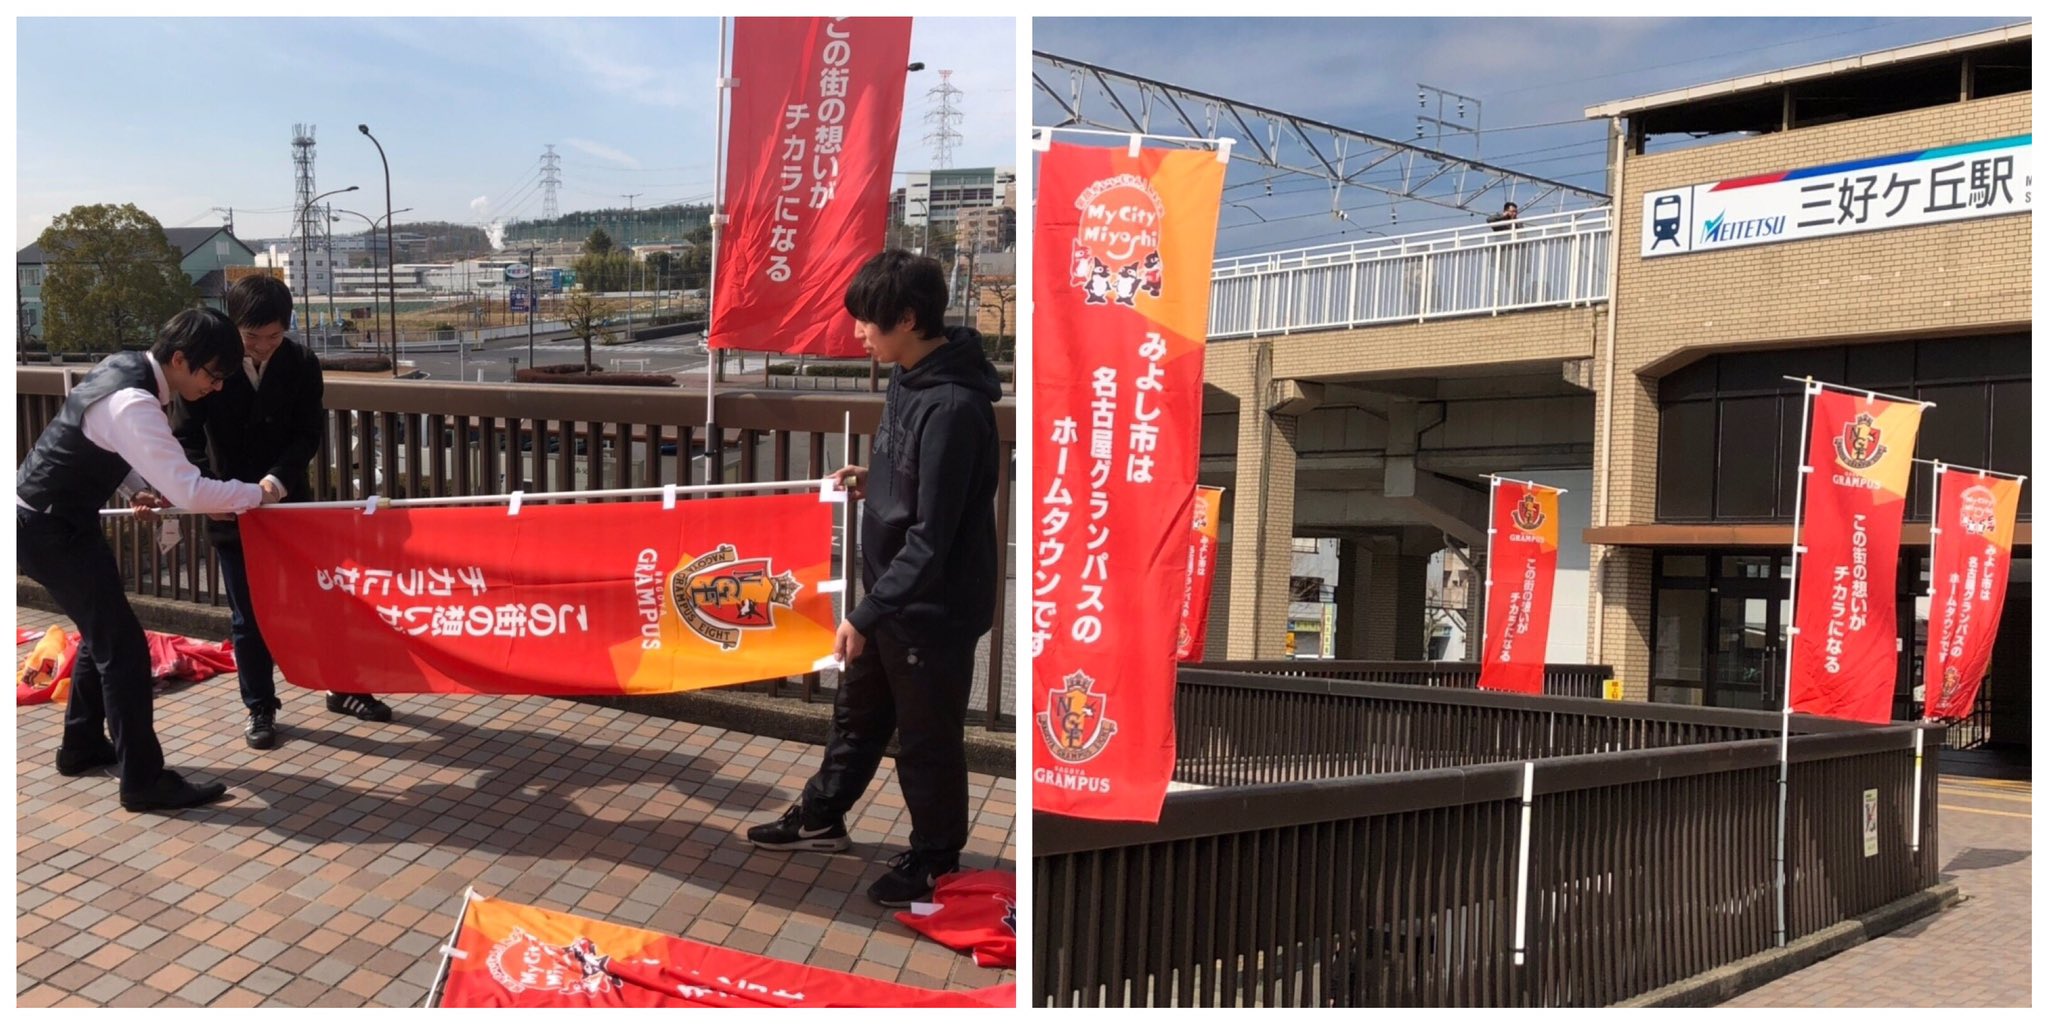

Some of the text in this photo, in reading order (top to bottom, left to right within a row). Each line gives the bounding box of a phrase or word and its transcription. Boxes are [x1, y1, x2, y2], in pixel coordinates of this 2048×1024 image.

[809, 16, 850, 209] この街の想いが
[765, 103, 810, 282] チカラになる
[1084, 225, 1157, 260] Miyoshi
[1700, 208, 1786, 244] MEITETSU
[1126, 332, 1167, 483] みよし市は
[1071, 366, 1118, 644] 名古屋グランパスの
[1832, 474, 1881, 489] GRAMPUS
[316, 566, 487, 597] チカラになる
[1031, 416, 1079, 658] ホームタウンです
[1848, 514, 1868, 632] この街の想いが
[1980, 544, 1997, 601] みよし市は
[634, 548, 662, 650] GRAMPUS
[673, 572, 696, 623] GRAMPUS
[698, 622, 732, 641] EIGHT
[1824, 566, 1850, 674] チカラになる
[1033, 767, 1111, 793] GRAMPUS
